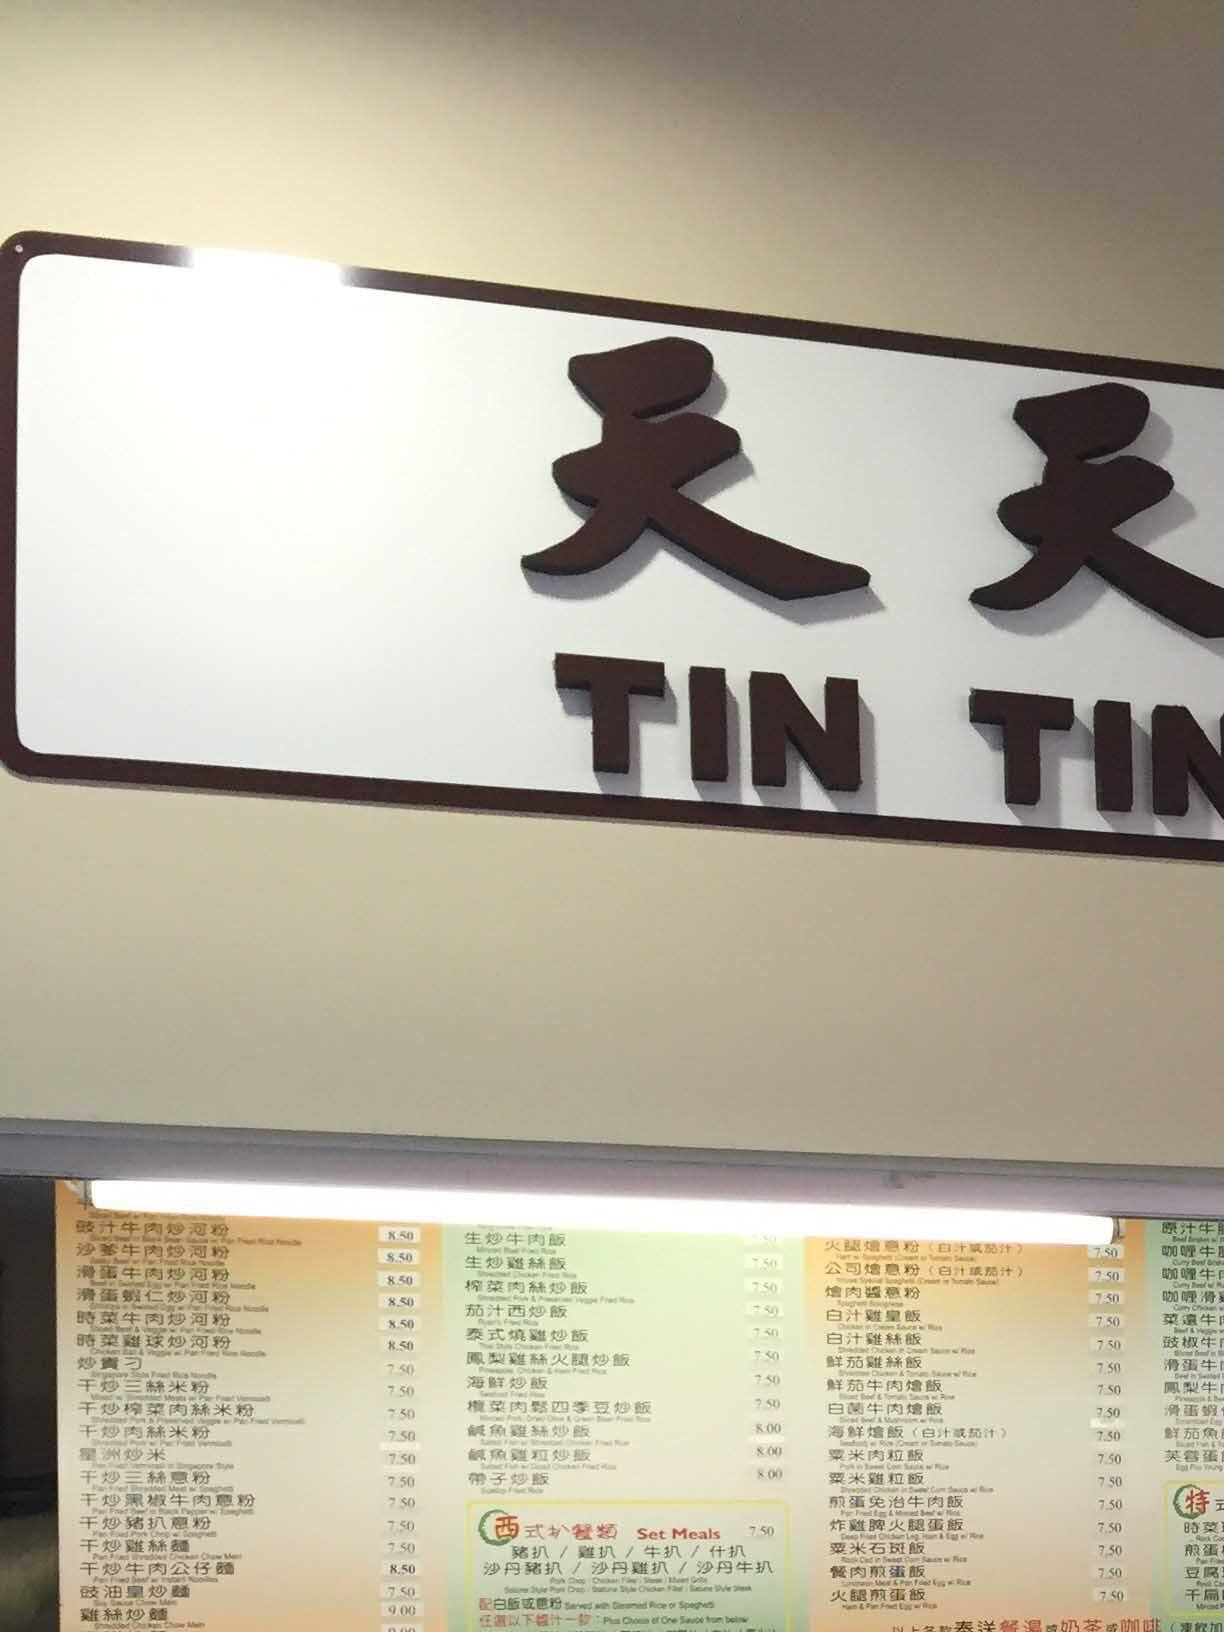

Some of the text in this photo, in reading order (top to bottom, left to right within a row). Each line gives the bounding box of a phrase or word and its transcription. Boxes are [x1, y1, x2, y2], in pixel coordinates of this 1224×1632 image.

[554, 652, 862, 792] TIN
[388, 1230, 414, 1241] 8.50
[388, 1274, 413, 1285] 8.50
[752, 1281, 778, 1294] 7.50
[1096, 1293, 1119, 1303] 7.50
[388, 1319, 414, 1329] 8.50
[1097, 1340, 1121, 1350] 7.50
[757, 1445, 782, 1457] 8.00
[388, 1453, 415, 1464] 7.50
[1098, 1453, 1121, 1464] 7.50
[757, 1469, 782, 1480] 8.00
[637, 1525, 774, 1540] Set Meals 7.50
[390, 1563, 416, 1574] 8.50
[1098, 1567, 1121, 1578] 7.50
[388, 1604, 416, 1615] 9.00
